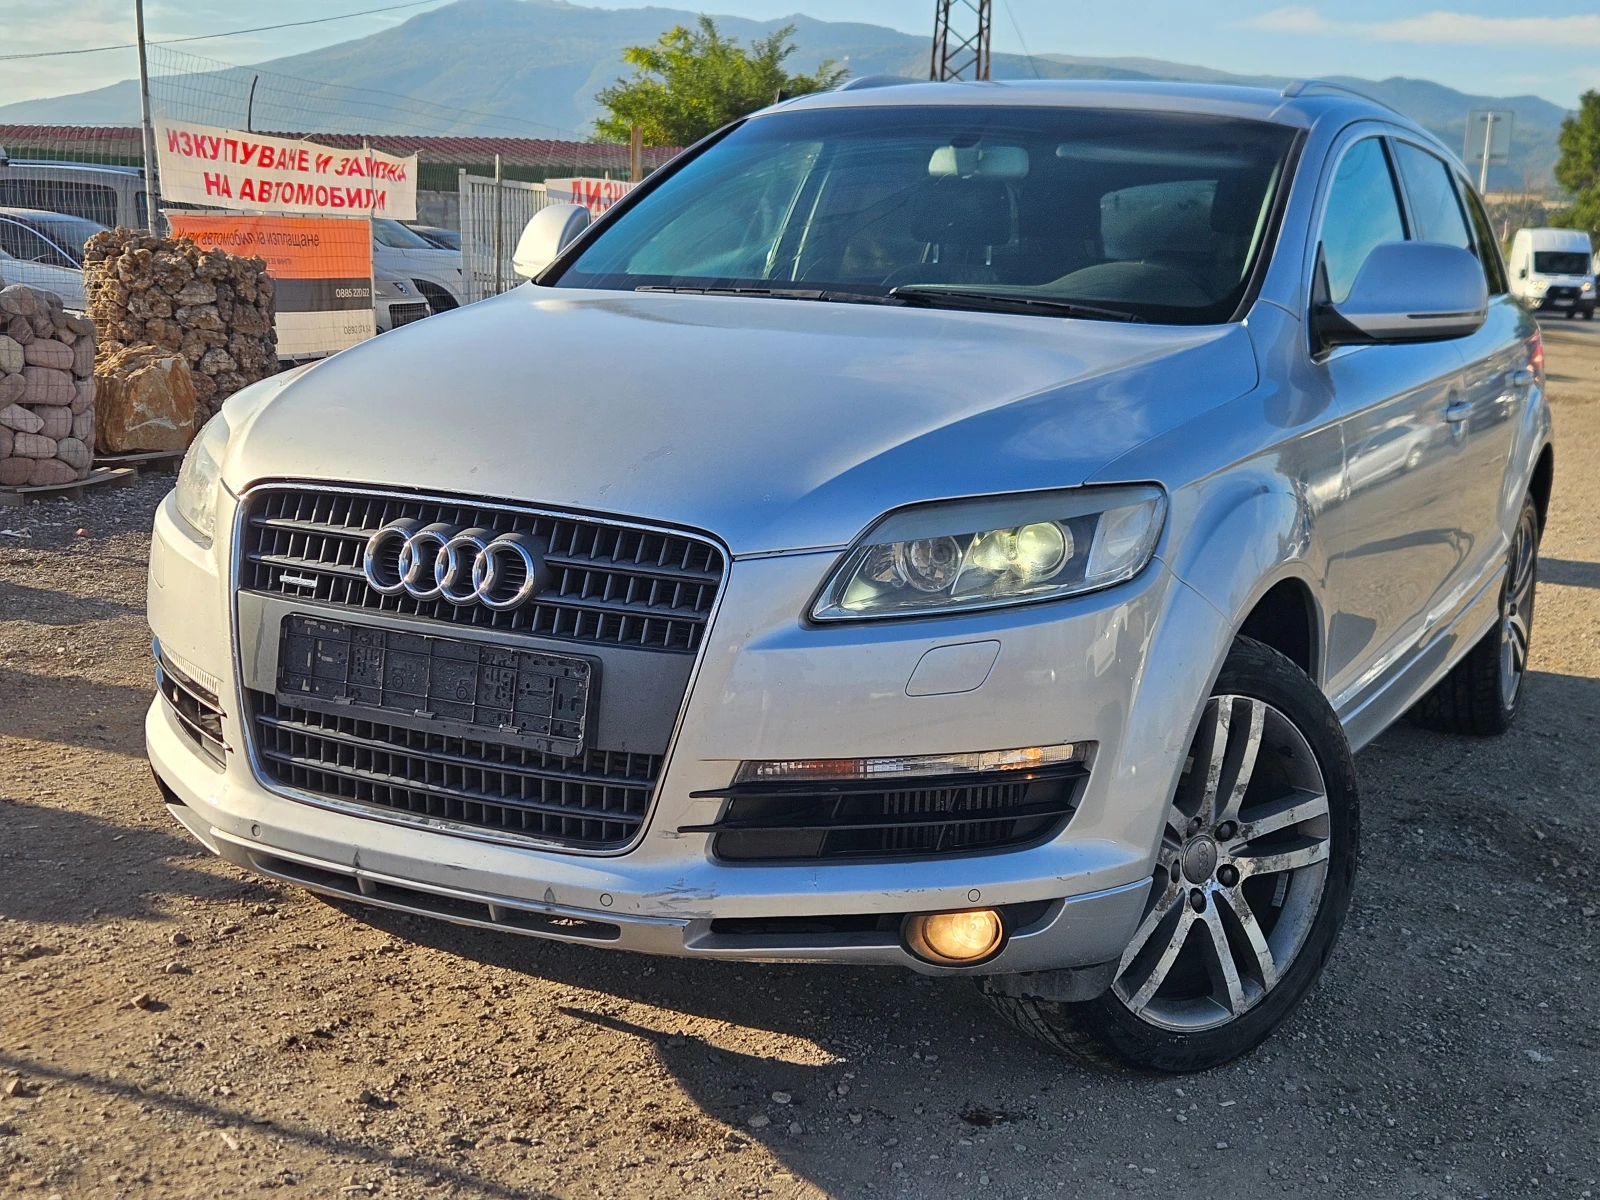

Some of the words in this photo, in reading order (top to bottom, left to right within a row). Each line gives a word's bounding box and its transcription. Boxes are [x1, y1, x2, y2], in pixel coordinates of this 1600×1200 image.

[165, 127, 309, 172] ИЗКУПУВАНЕ
[315, 153, 334, 174] И
[203, 172, 232, 199] НА
[239, 178, 387, 210] АВТОМОБИЛИ
[266, 232, 320, 249] изплащане
[335, 288, 353, 298] 0885
